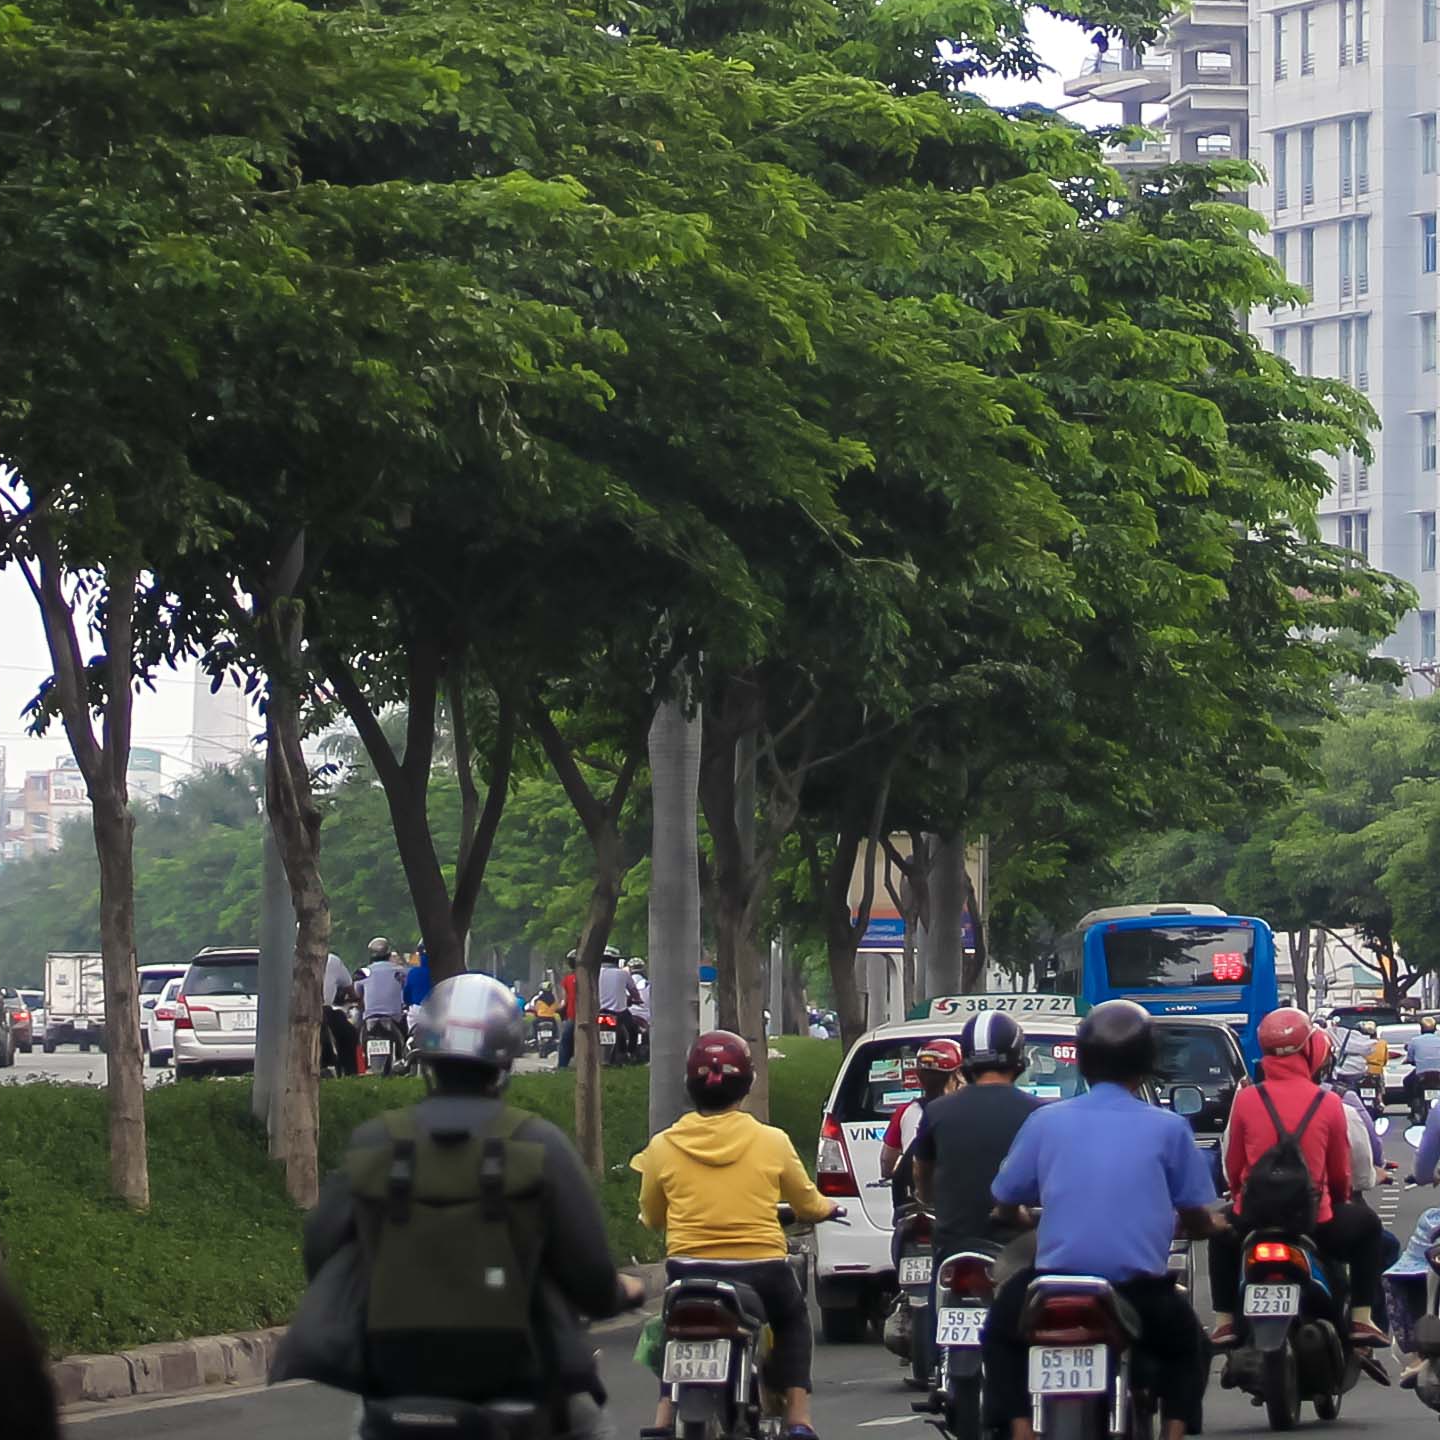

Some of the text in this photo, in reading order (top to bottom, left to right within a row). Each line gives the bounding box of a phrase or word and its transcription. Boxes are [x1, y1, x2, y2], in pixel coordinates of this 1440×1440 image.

[1023, 998, 1044, 1011] 27
[1050, 997, 1073, 1011] 27
[1252, 1300, 1290, 1313] 2230
[1042, 1348, 1094, 1368] 65-H8
[1041, 1368, 1093, 1390] 2301
